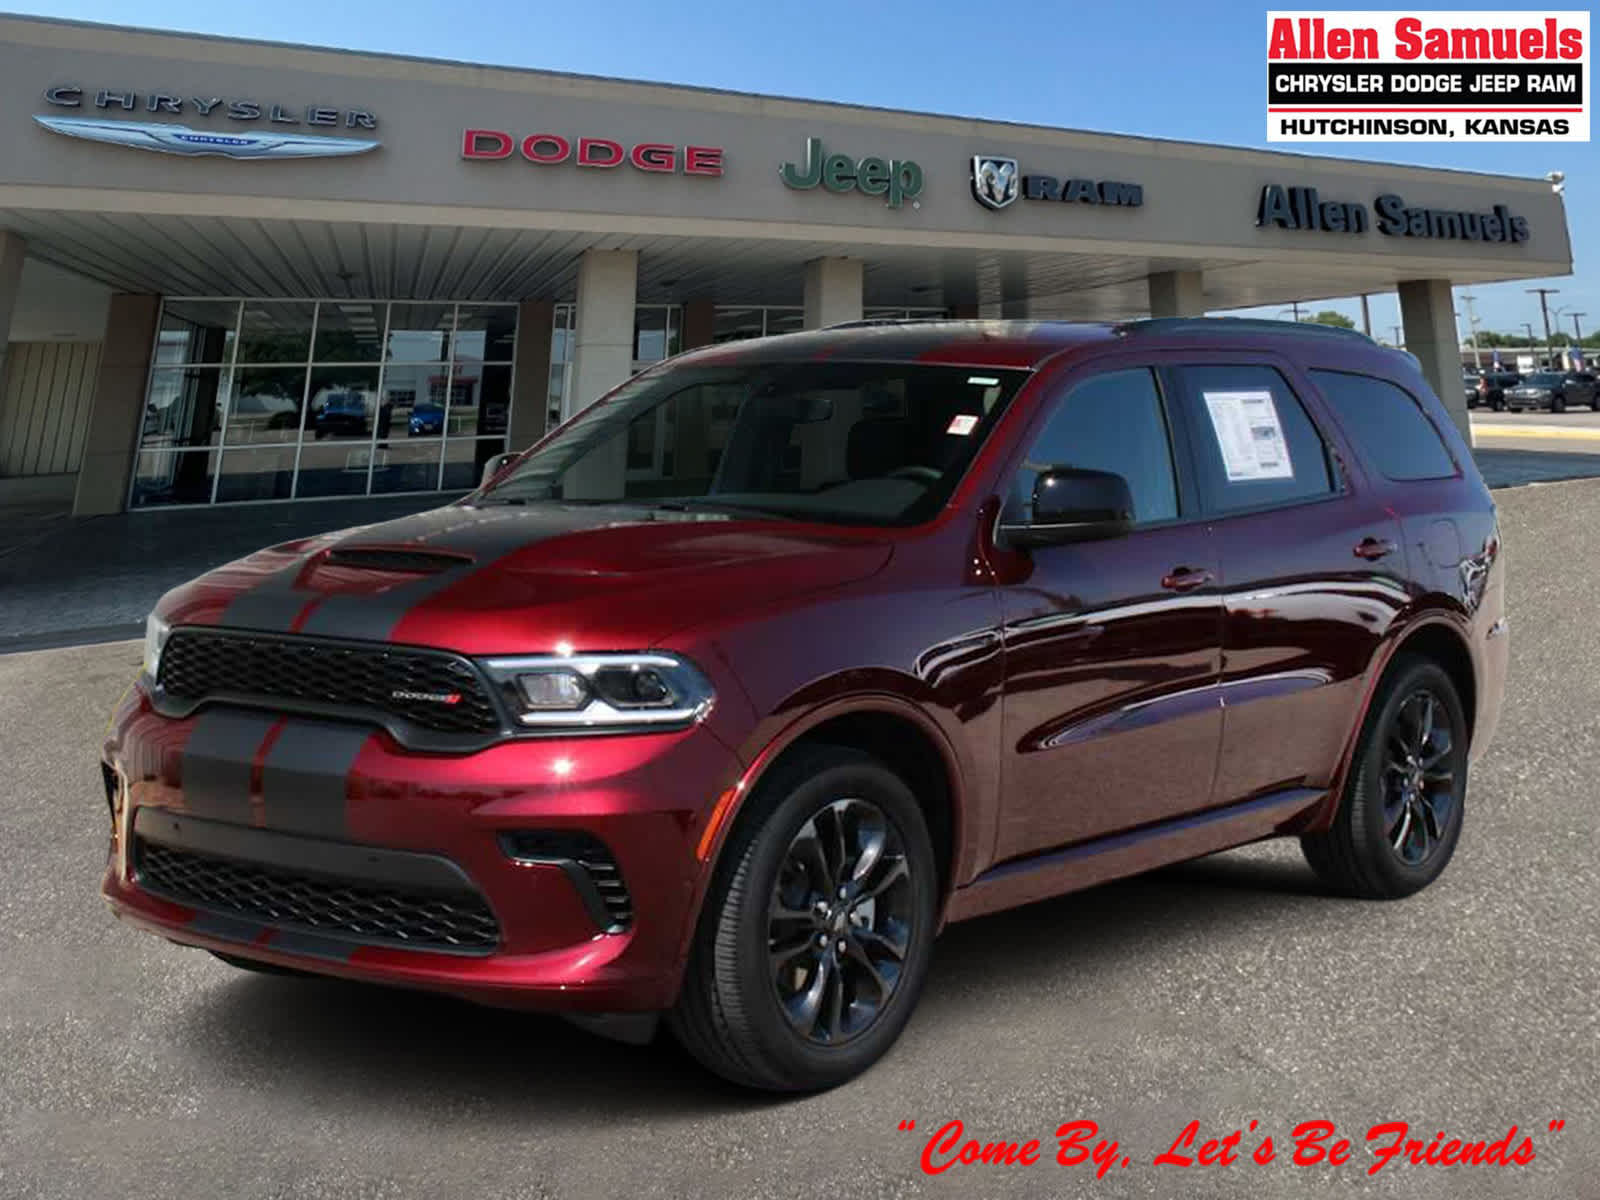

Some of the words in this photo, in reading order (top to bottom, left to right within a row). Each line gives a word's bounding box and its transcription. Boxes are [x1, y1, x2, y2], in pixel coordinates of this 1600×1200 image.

[45, 86, 378, 129] CHRYSLER
[461, 129, 724, 177] DODGE
[779, 136, 925, 209] Jeep
[1022, 175, 1144, 207] RAM
[1255, 183, 1369, 233] Allen
[1374, 194, 1530, 243] Samuels
